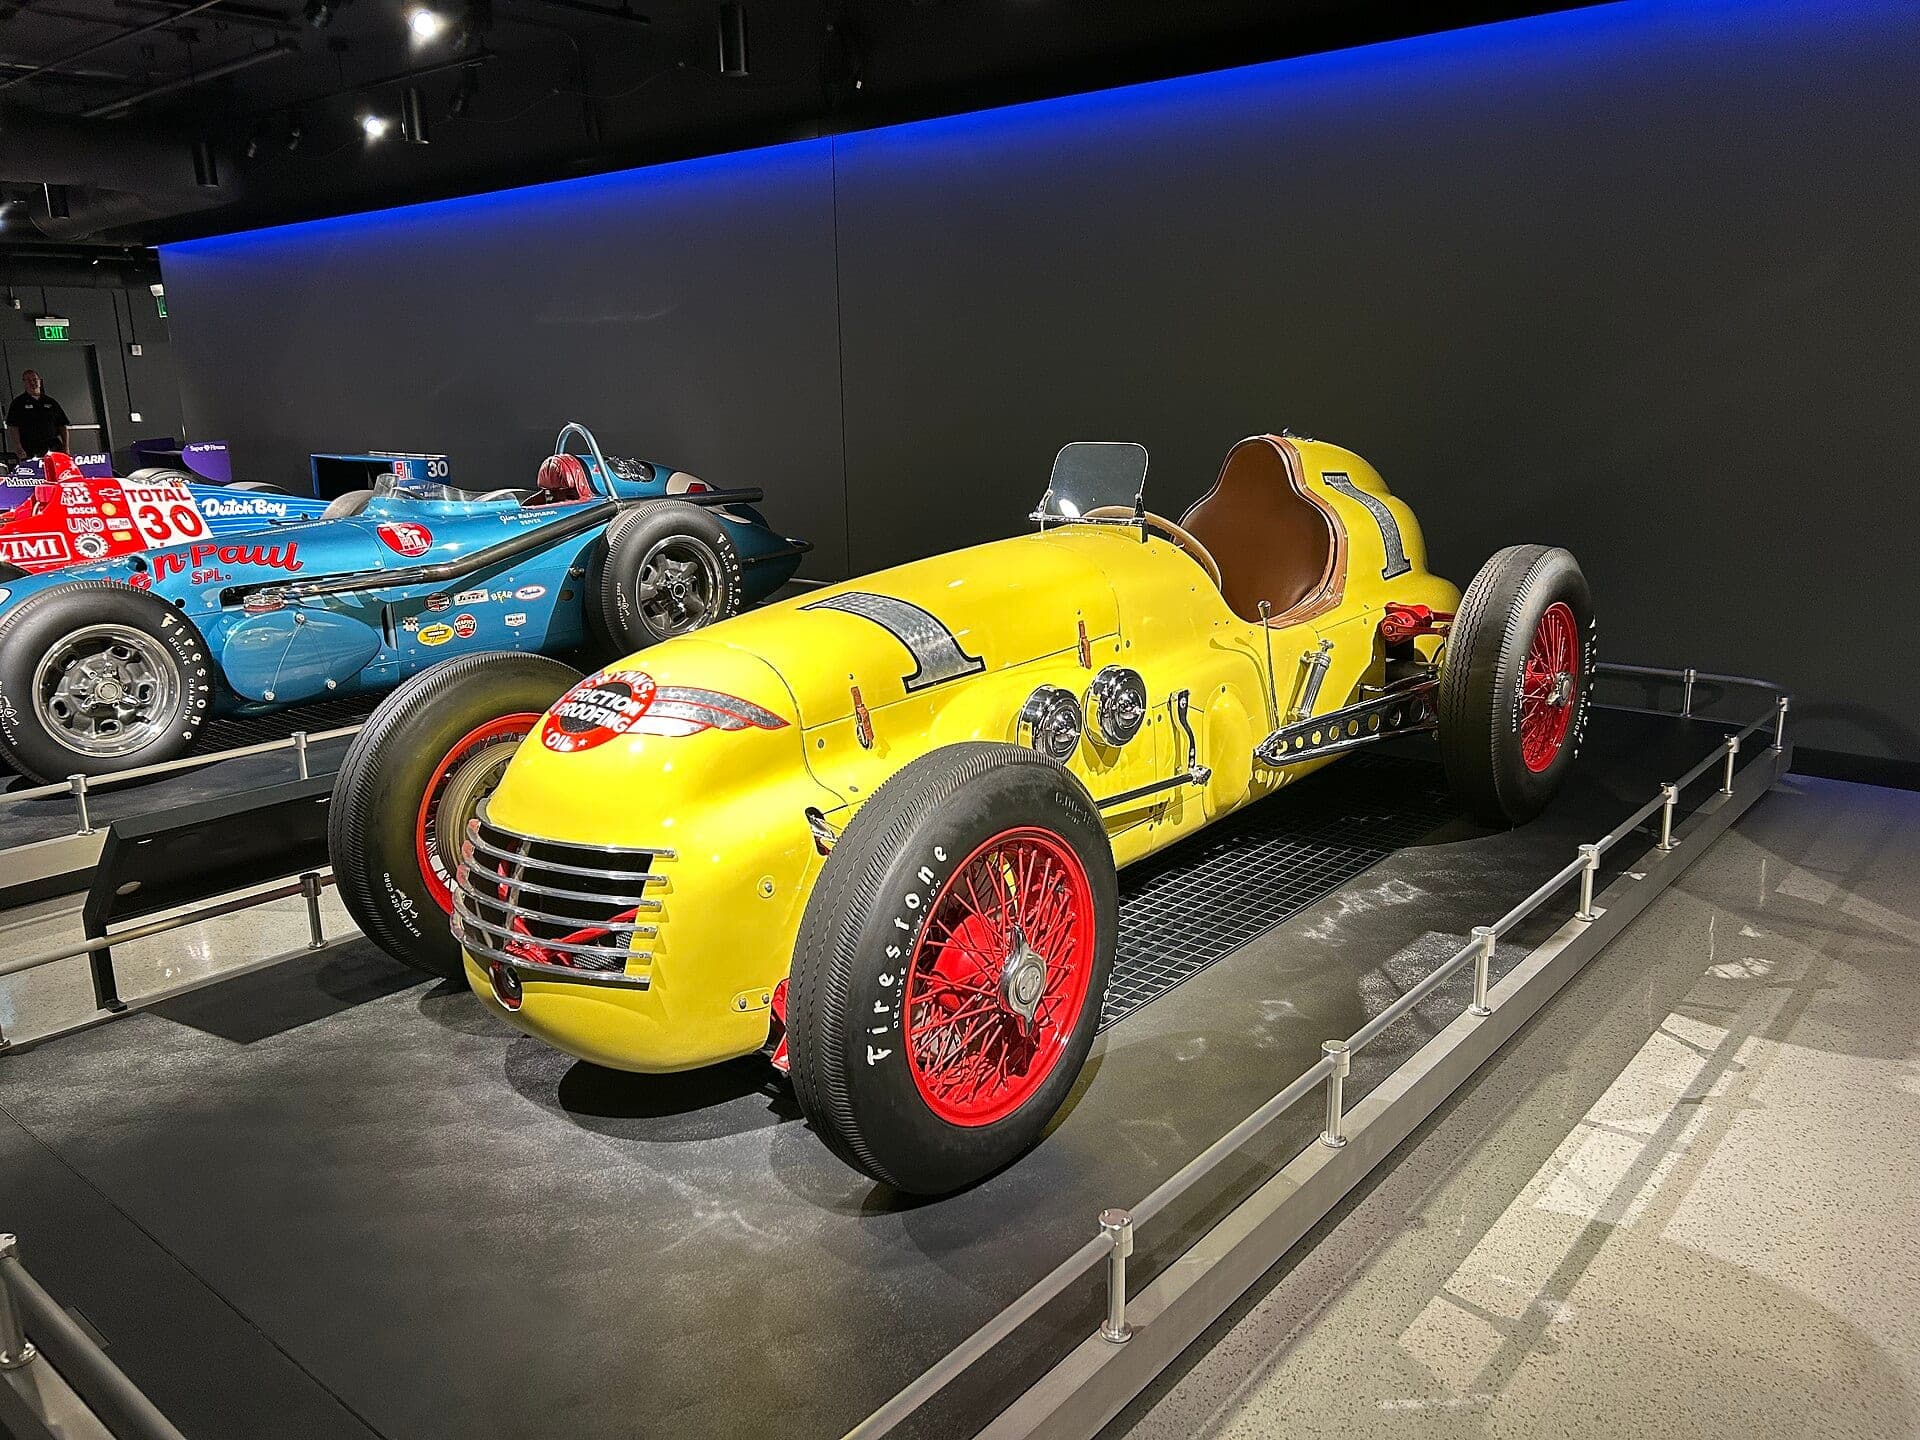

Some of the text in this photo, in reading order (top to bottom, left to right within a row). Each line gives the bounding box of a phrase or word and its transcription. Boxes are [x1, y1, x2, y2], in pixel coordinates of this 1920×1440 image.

[44, 326, 64, 339] EXIT
[427, 460, 449, 478] 30
[66, 506, 98, 515] BOSCH
[125, 488, 191, 503] TOTAL
[201, 498, 287, 518] Dutch Boy
[66, 517, 105, 534] UNO
[139, 505, 204, 541] 30
[102, 542, 304, 589] en-Paul
[191, 568, 232, 585] SPL.
[168, 636, 191, 666] DELUXE
[160, 612, 209, 741] Firestone
[568, 687, 646, 717] FRICTION
[554, 701, 632, 734] PROOFING
[866, 846, 948, 1067] Firestone
[892, 967, 907, 1029] DELUXE
